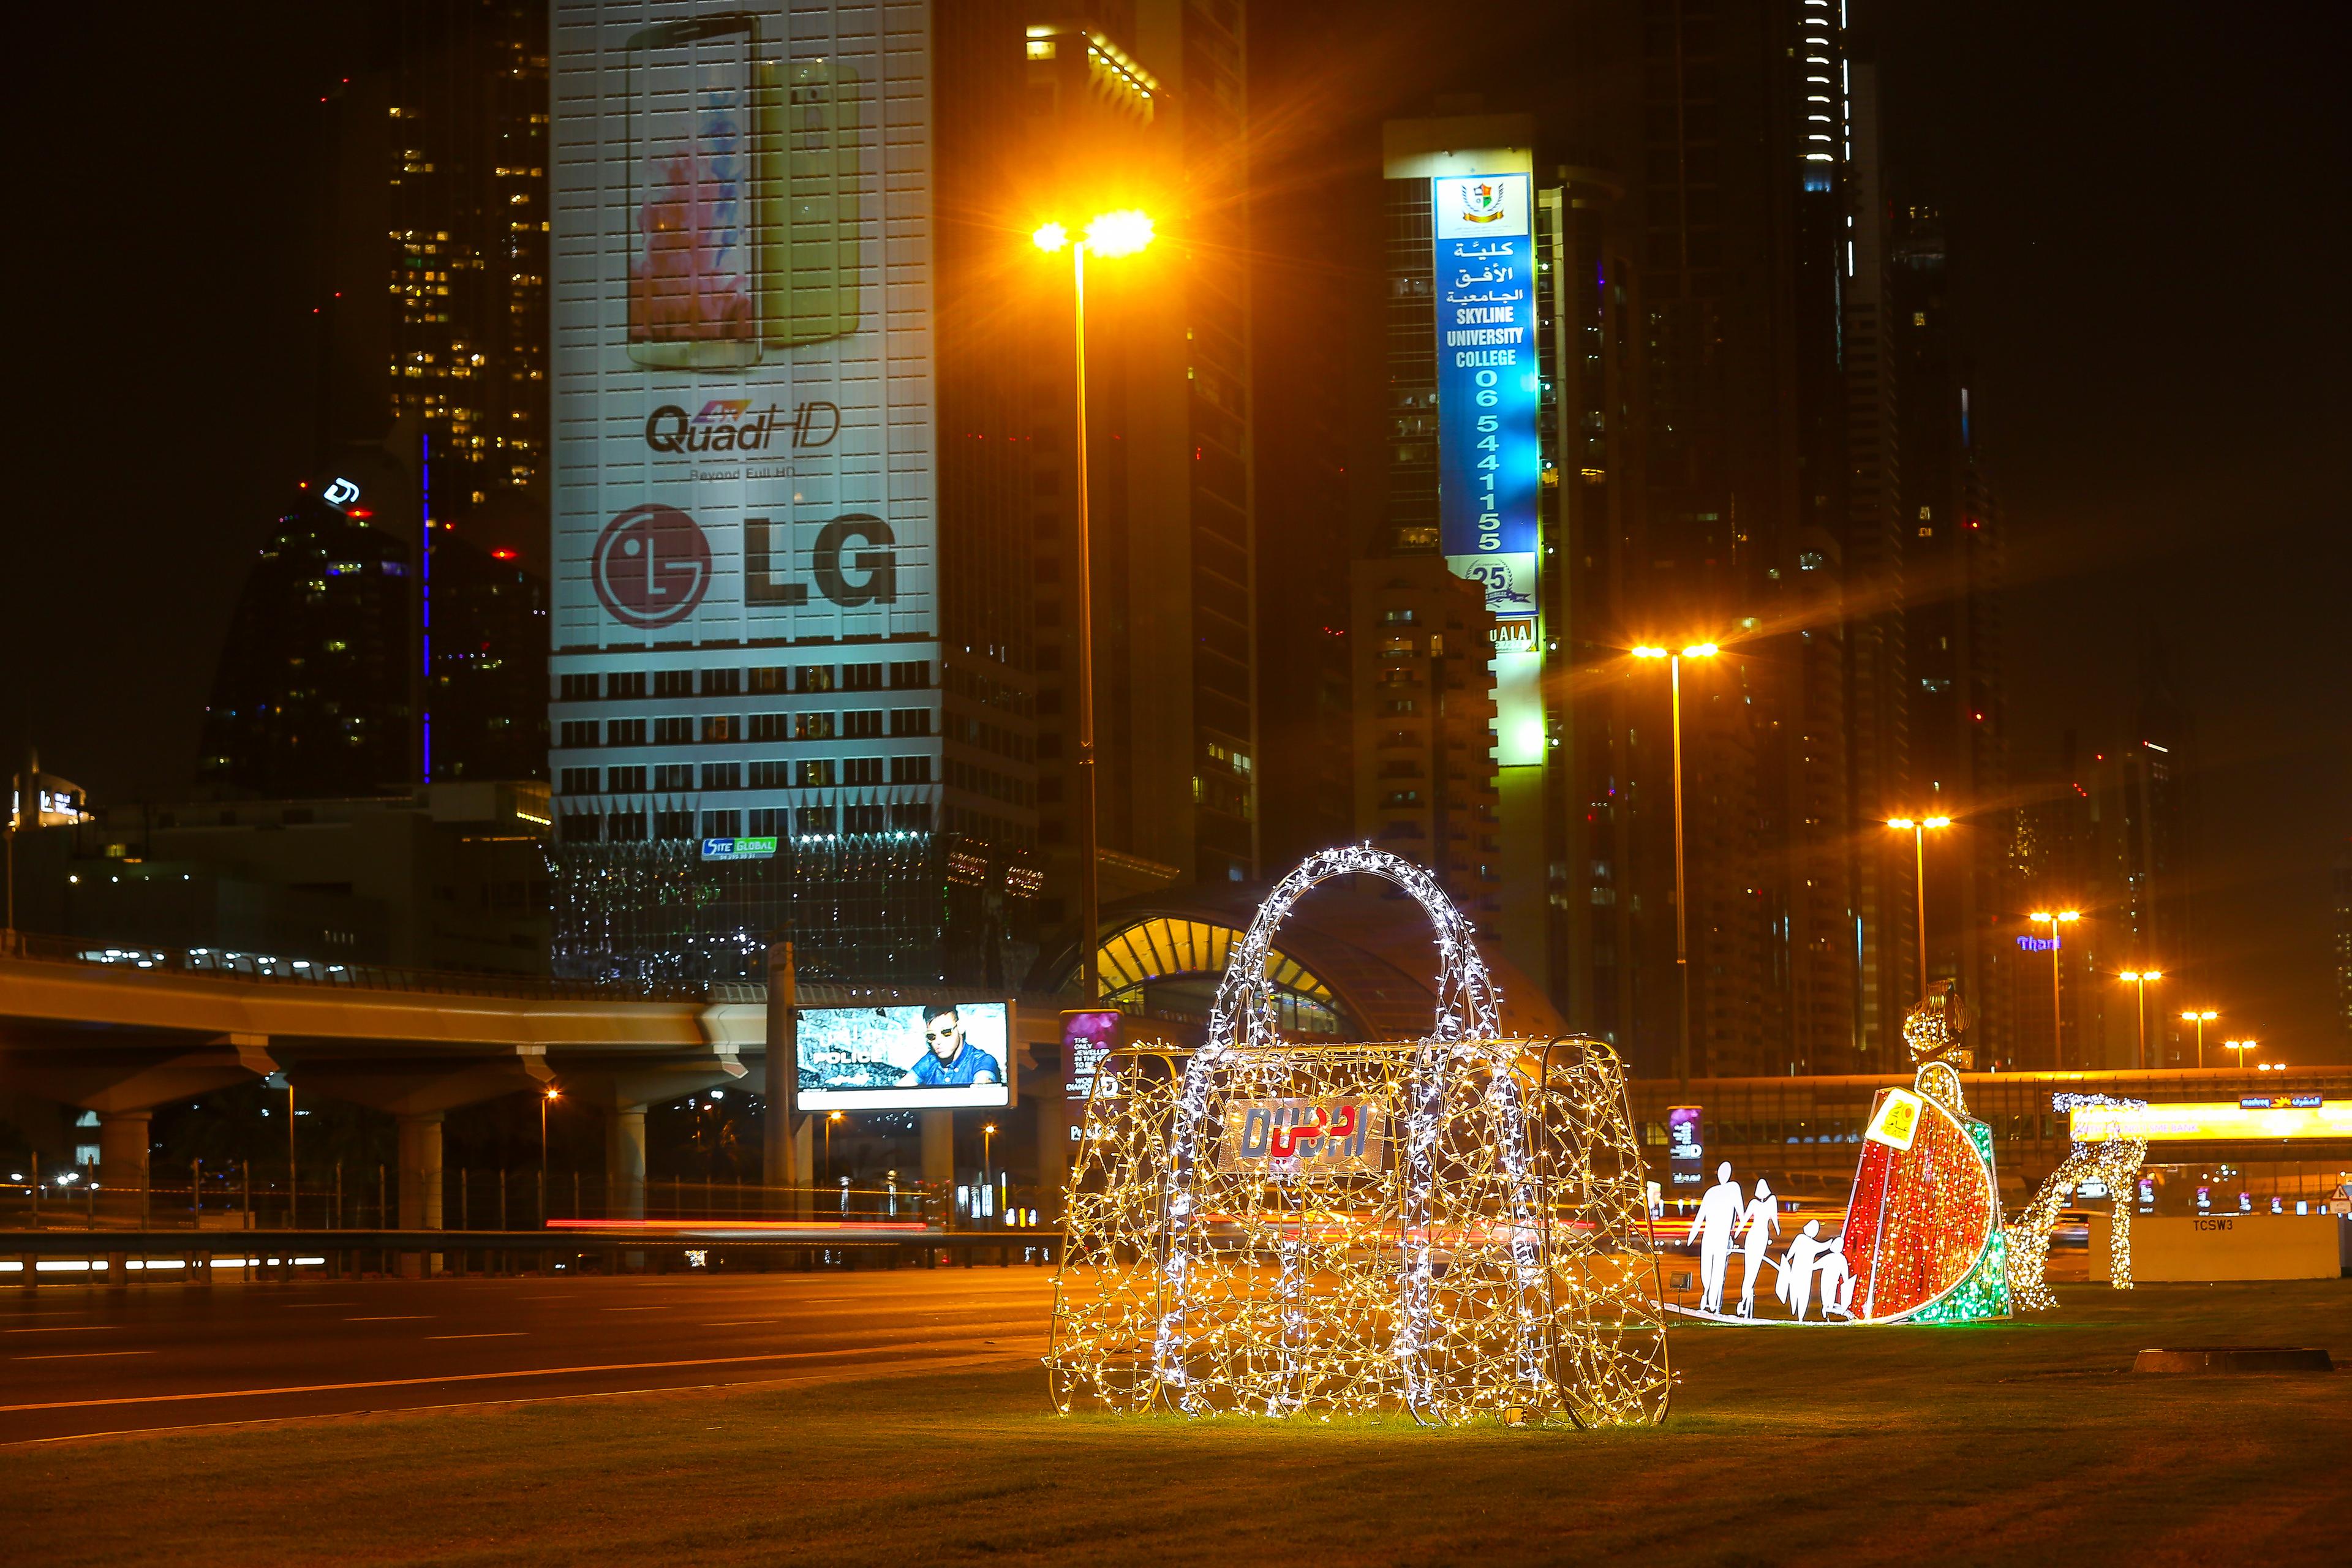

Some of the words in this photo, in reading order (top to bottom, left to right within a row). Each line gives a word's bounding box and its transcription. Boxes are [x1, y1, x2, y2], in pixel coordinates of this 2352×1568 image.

[1457, 306, 1514, 325] SKYLINE
[1447, 327, 1524, 347] UNIVERSITY
[1455, 349, 1517, 368] COLLEGE
[690, 469, 740, 482] Beyond
[745, 467, 770, 479] Full
[776, 466, 795, 477] HD
[744, 513, 897, 607] LG
[1472, 567, 1505, 589] 25
[708, 839, 734, 855] SITE
[737, 841, 773, 851] GLOBAL
[813, 1052, 883, 1064] POLICE
[1888, 1099, 1915, 1122] 20
[2241, 1098, 2270, 1108] mashreq
[1241, 1106, 1368, 1157] DUBAI
[2193, 1219, 2233, 1231] TCSW3
